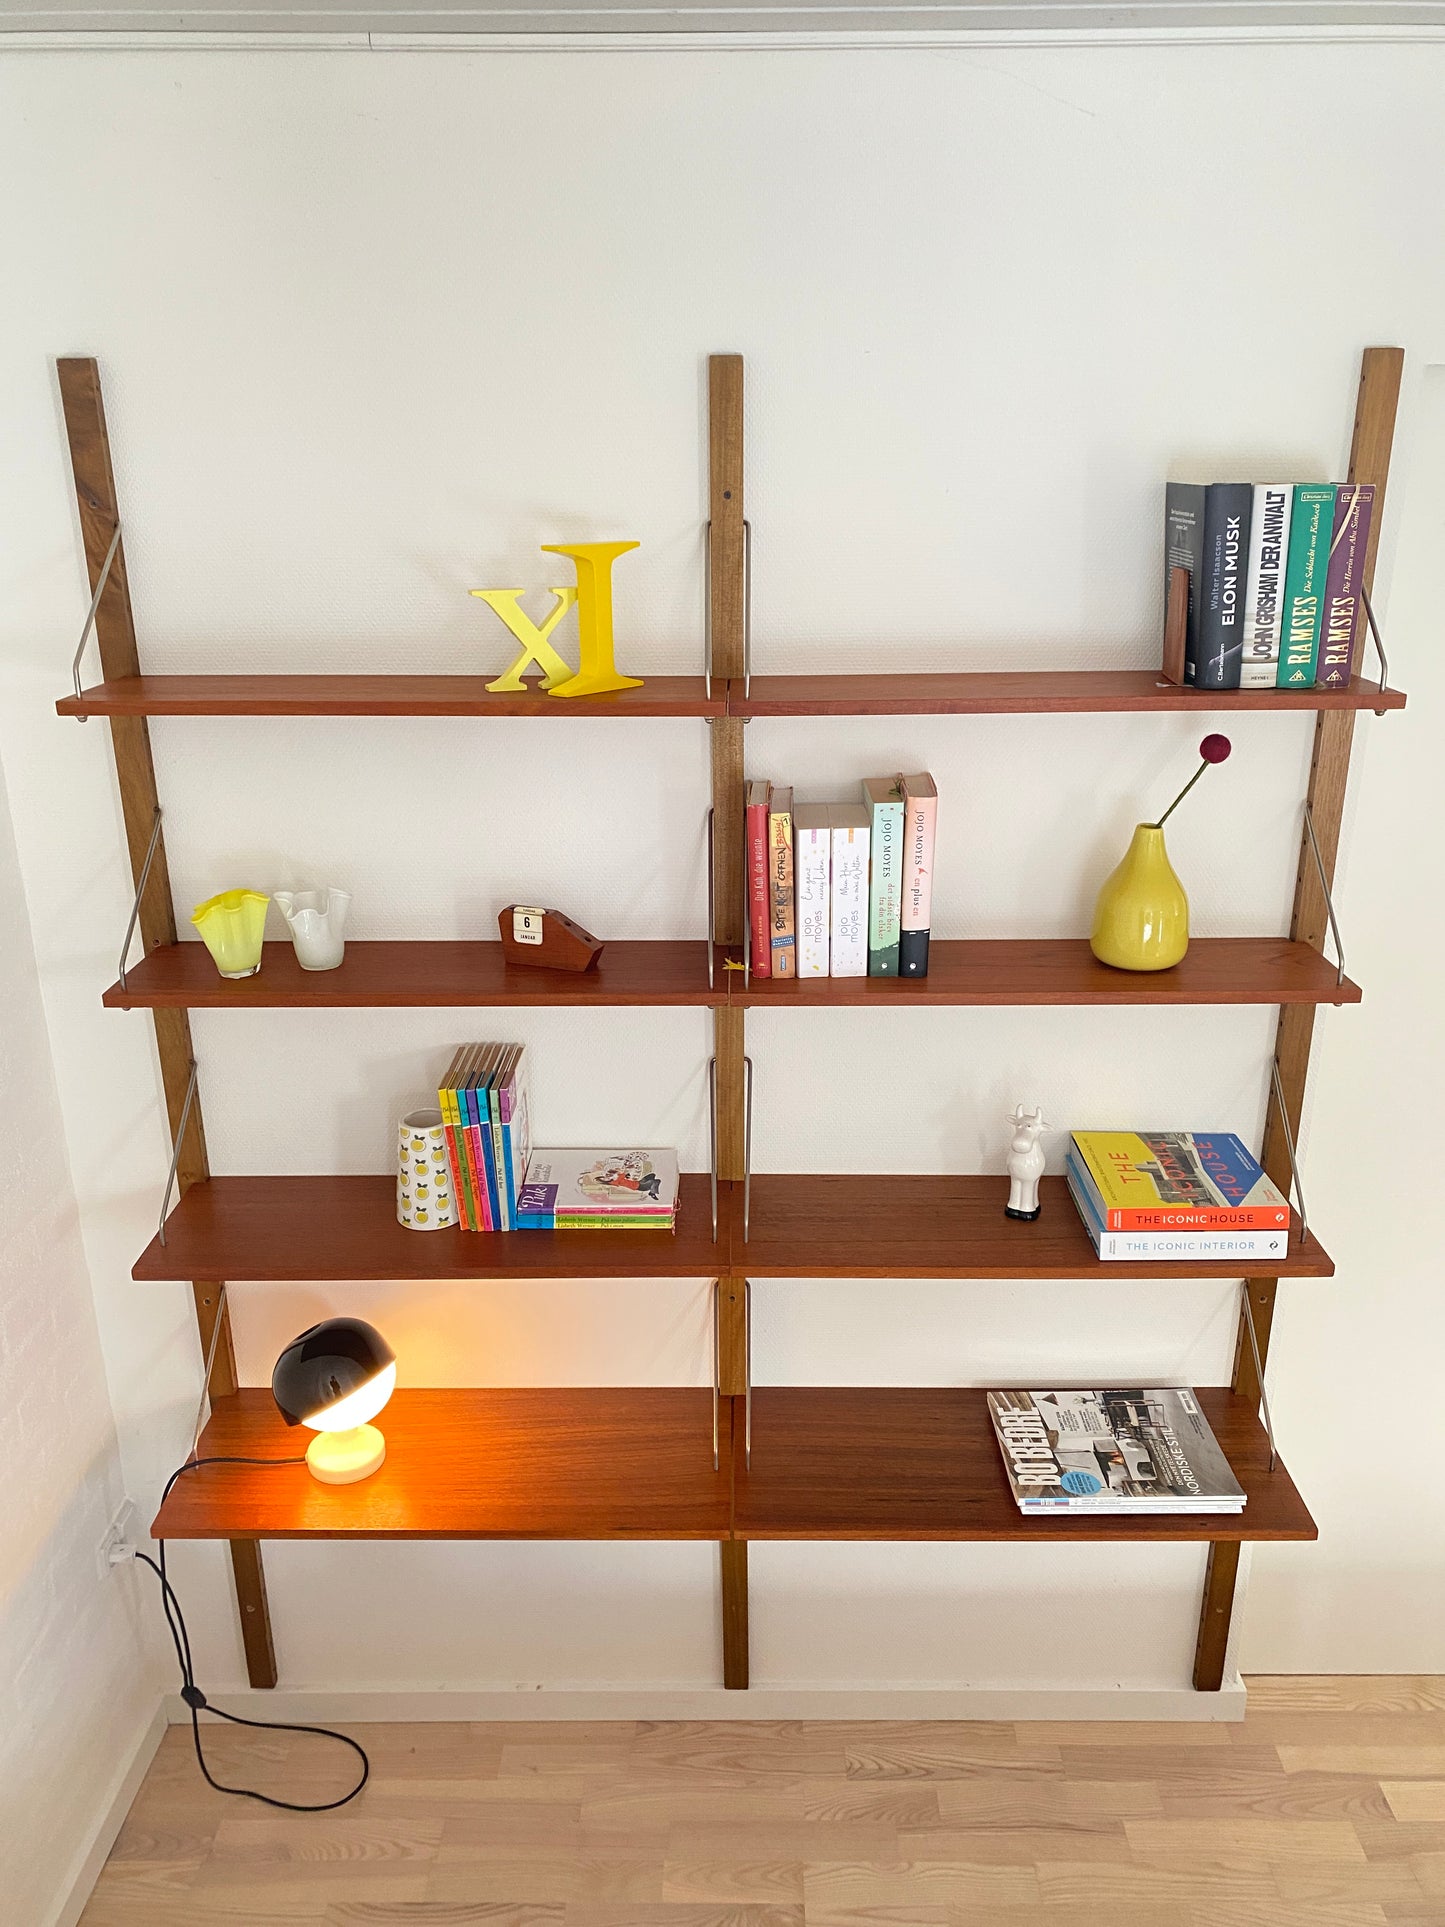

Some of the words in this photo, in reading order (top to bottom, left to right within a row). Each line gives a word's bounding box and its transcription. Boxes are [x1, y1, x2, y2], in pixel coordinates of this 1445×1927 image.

[1263, 491, 1285, 545] ANWALT
[1351, 505, 1361, 529] Simbel
[1225, 516, 1240, 571] MUSK
[1349, 530, 1357, 544] Abu
[1213, 534, 1222, 575] Isaacson
[1259, 546, 1280, 569] DER
[1344, 558, 1353, 581] Herrin
[1210, 578, 1219, 610] Walter
[1222, 576, 1237, 625] ELON
[1255, 574, 1278, 625] GRISHAM
[1288, 596, 1317, 664] RAMSES
[1304, 580, 1312, 592] Die
[1325, 596, 1355, 665] RAMSES
[1252, 628, 1273, 659] JOHN
[881, 818, 892, 842] JOJO
[915, 810, 925, 832] JOJO
[754, 838, 762, 861] weinte
[915, 835, 923, 865] MOYES
[754, 863, 763, 873] die
[774, 847, 786, 880] ÖFFNEN
[813, 858, 825, 880] Leben
[883, 846, 891, 878] MOYES
[801, 886, 813, 900] Ein
[914, 878, 921, 886] en
[754, 890, 764, 901] Die
[911, 888, 922, 906] plus
[524, 916, 530, 928] 6
[912, 907, 919, 916] en
[802, 918, 815, 937] jojo
[814, 911, 825, 943] moyes
[839, 917, 851, 937] jojo
[850, 910, 861, 943] moyes
[1109, 1152, 1142, 1184] THE
[1147, 1141, 1200, 1199] ICONIC
[1192, 1141, 1246, 1198] HOUSE
[522, 1185, 547, 1208] Puk
[1136, 1216, 1160, 1224] THE
[1162, 1214, 1208, 1224] ICONIC
[1210, 1214, 1254, 1223] HOUSE
[1126, 1242, 1149, 1251] THE
[1154, 1242, 1195, 1250] ICONIC
[1200, 1241, 1255, 1250] INTERIOR
[998, 1406, 1054, 1460] BEDRE
[1159, 1427, 1179, 1445] STIL
[1014, 1463, 1061, 1486] BO
[1169, 1447, 1203, 1494] NORDISKE
